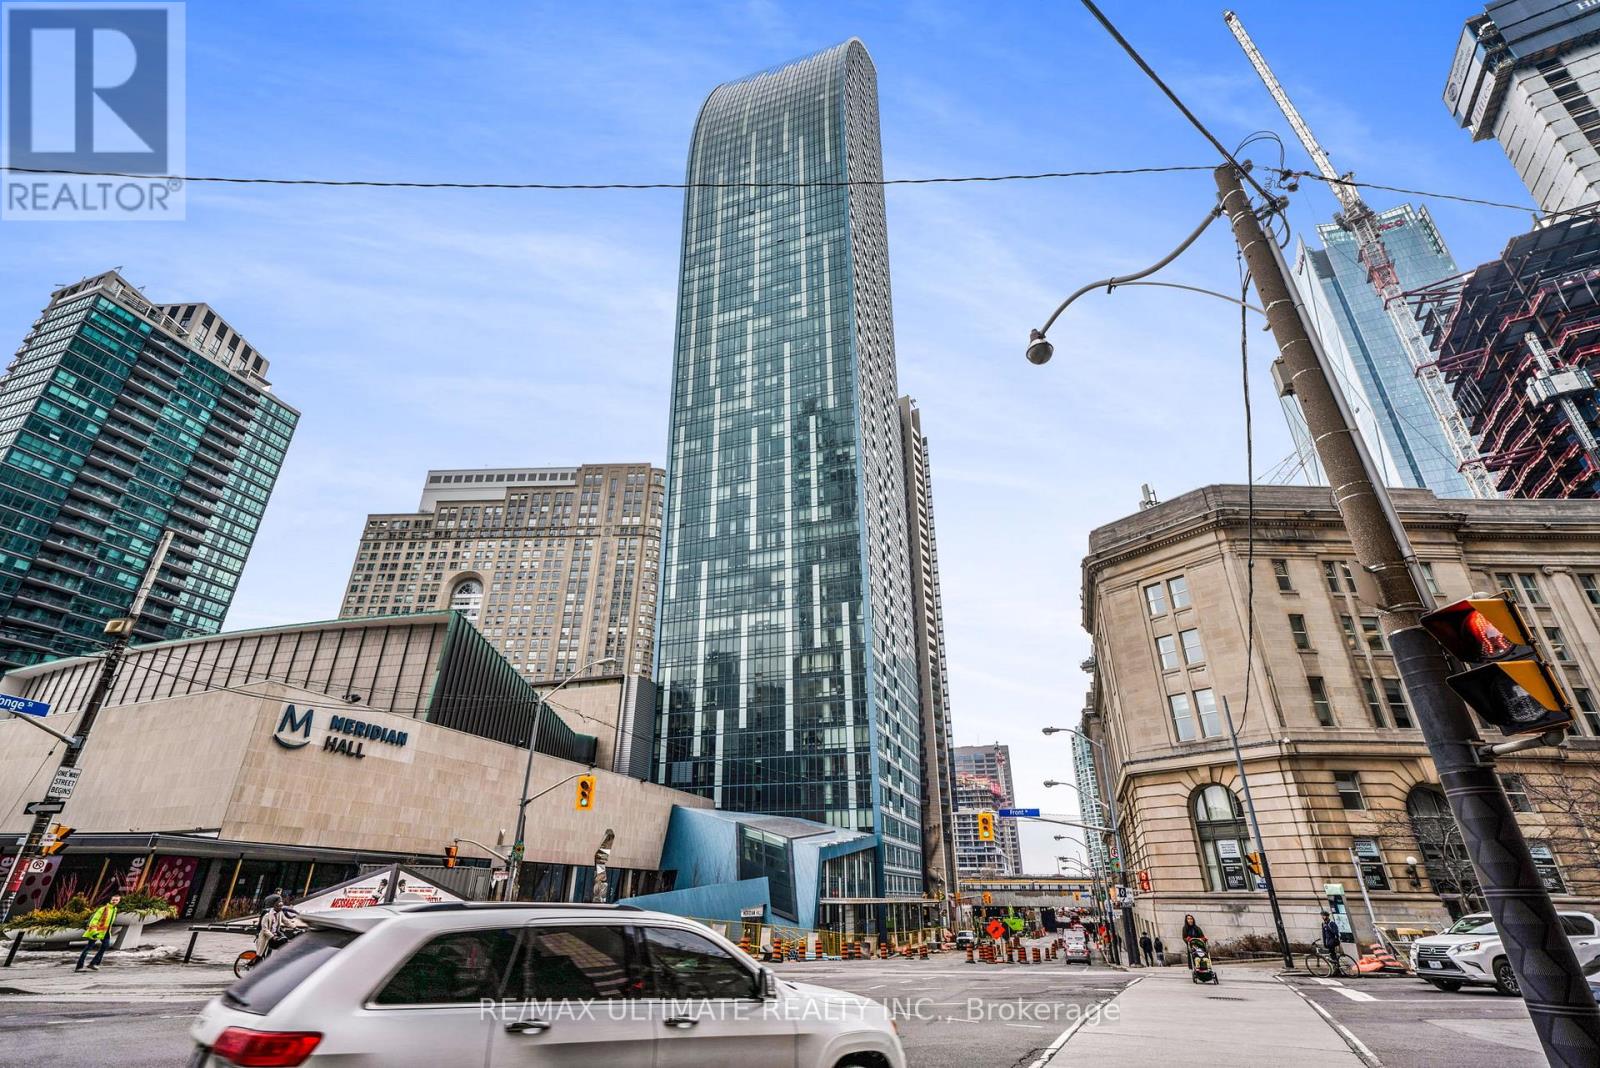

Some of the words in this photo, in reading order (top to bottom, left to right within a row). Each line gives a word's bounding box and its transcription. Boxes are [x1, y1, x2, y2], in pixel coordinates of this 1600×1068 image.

[0, 693, 25, 711] onge
[329, 714, 409, 746] MERIDIAN
[323, 735, 366, 758] HALL
[50, 786, 72, 795] BEGINS
[54, 777, 76, 787] STREET
